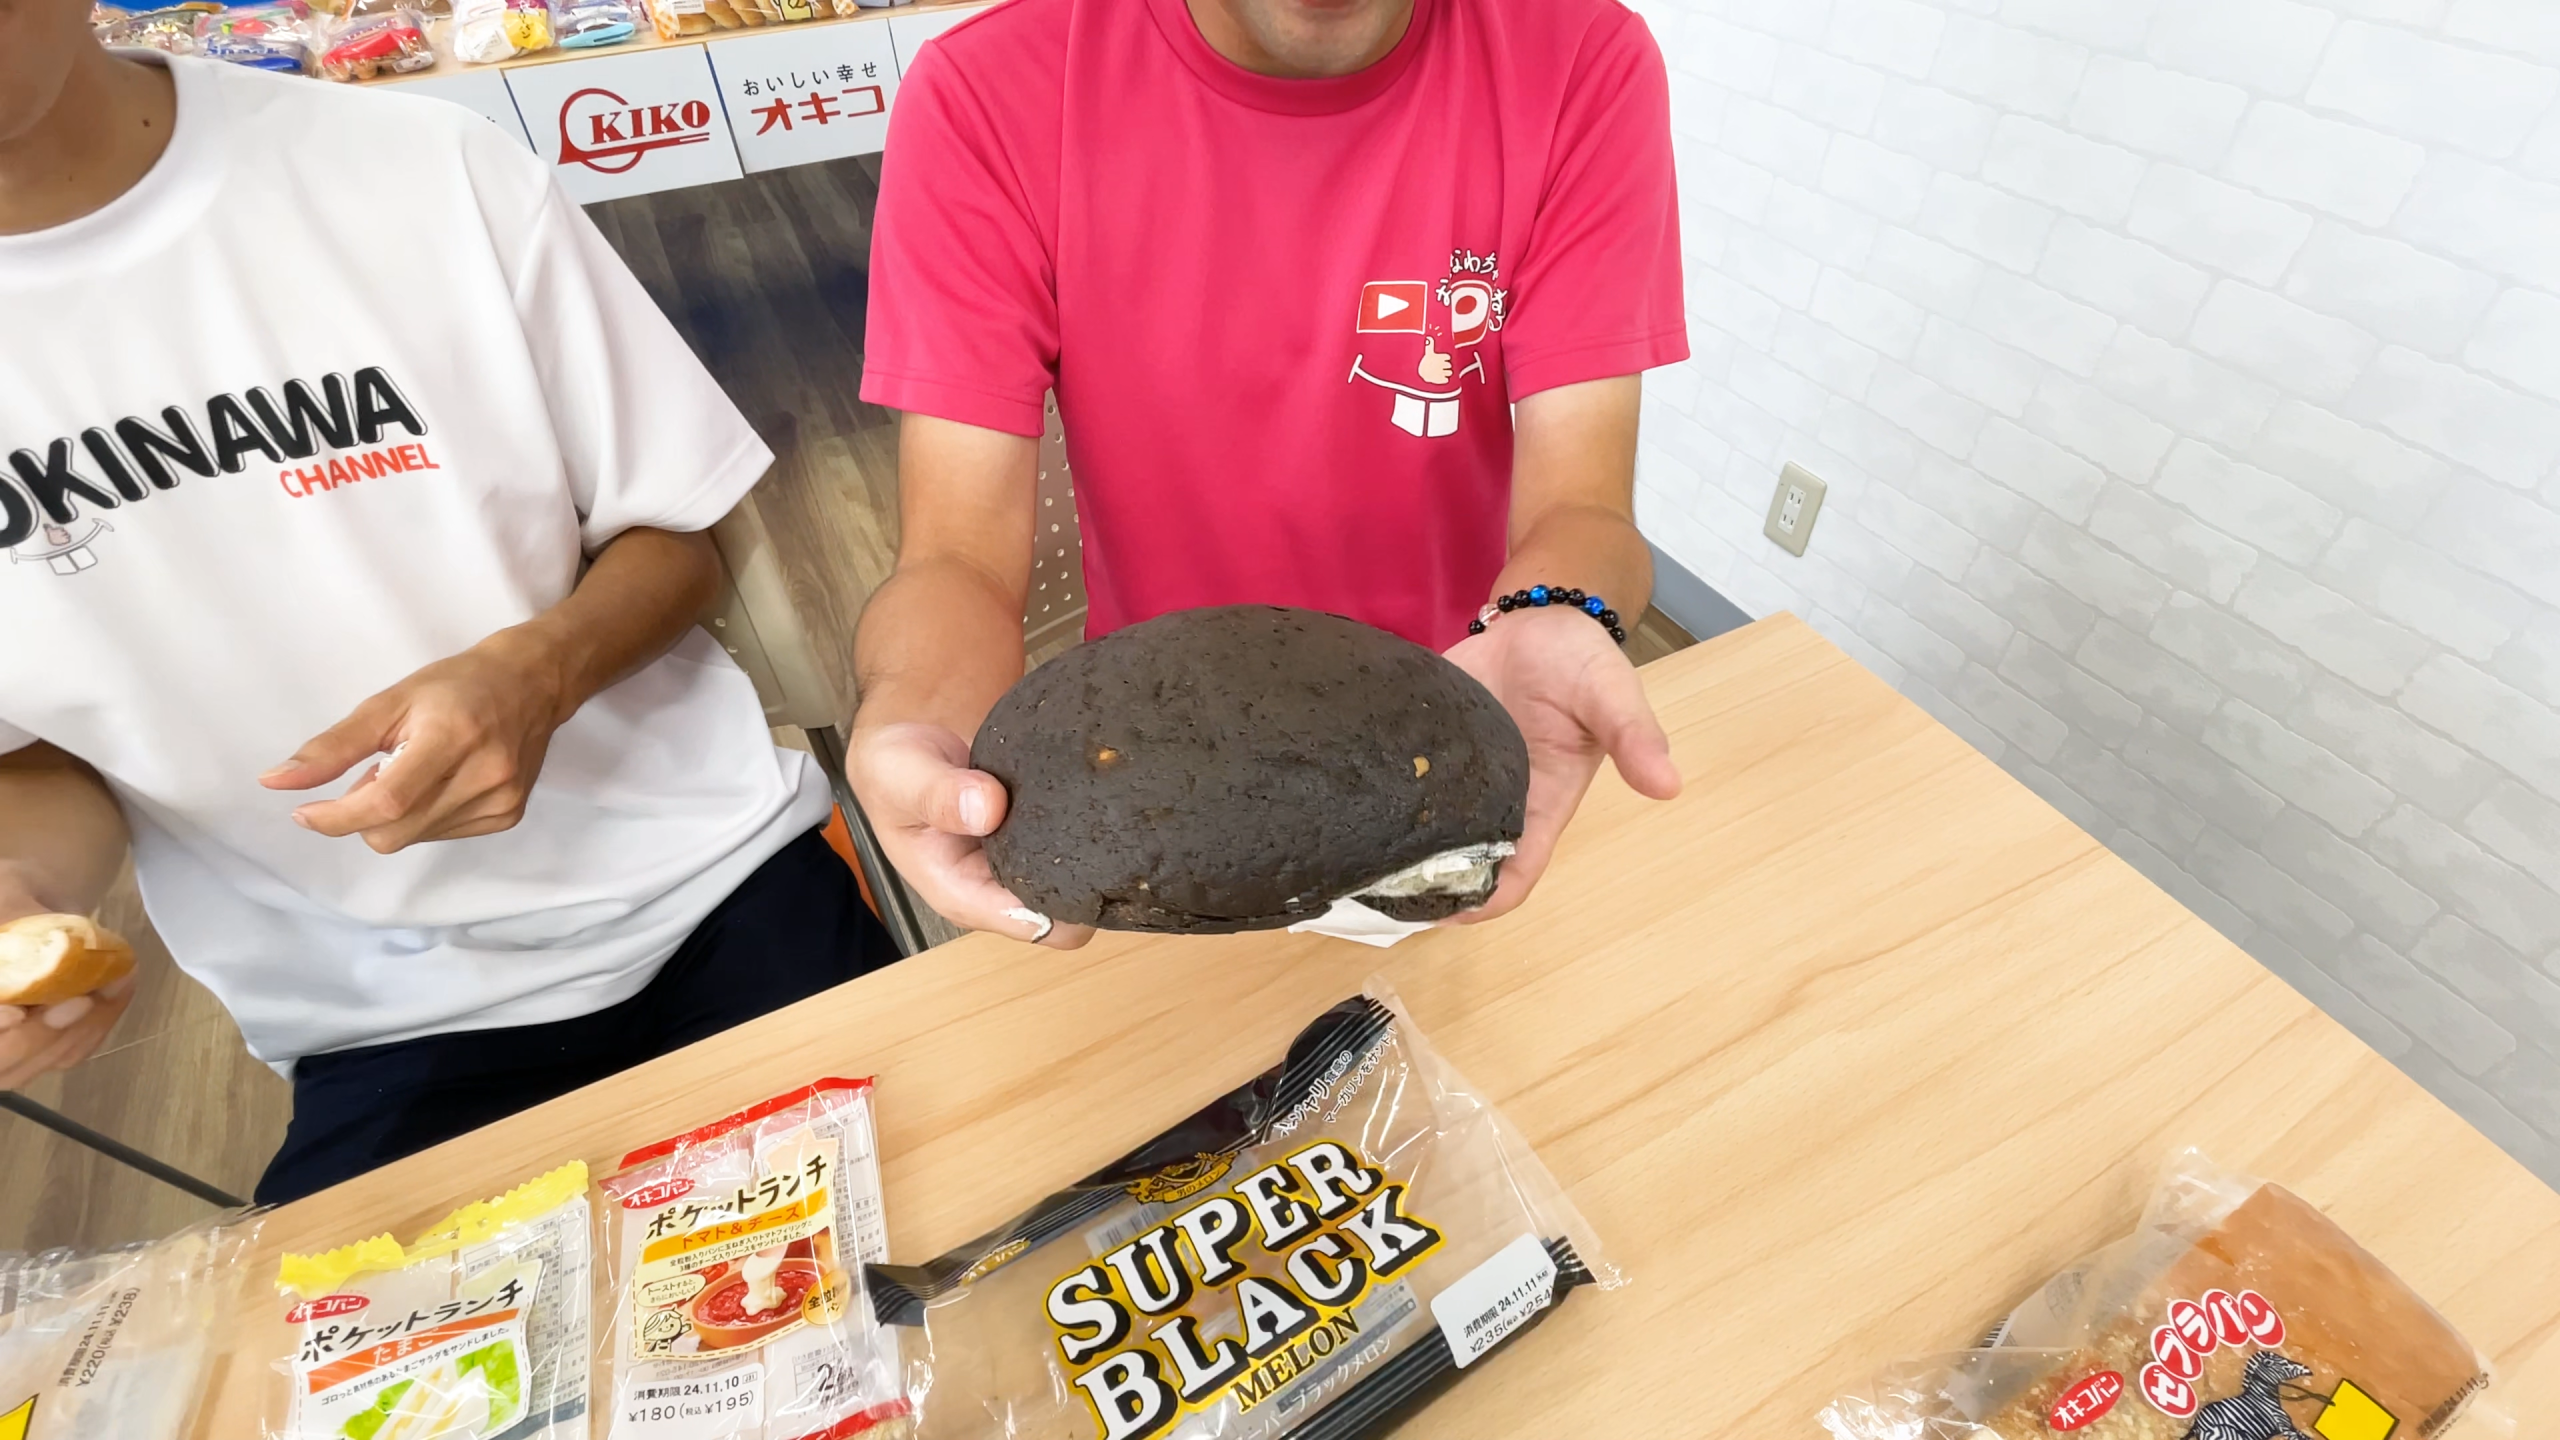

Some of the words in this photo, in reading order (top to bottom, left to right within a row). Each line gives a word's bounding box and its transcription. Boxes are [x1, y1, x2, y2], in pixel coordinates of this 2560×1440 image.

[743, 61, 878, 96] おいしい幸せ
[750, 84, 886, 136] オキコ
[279, 443, 440, 498] CHANNEL
[628, 1182, 695, 1207] オキコパン
[646, 1154, 828, 1240] ポケットランチ
[1045, 1141, 1384, 1366] SUPER
[300, 1278, 525, 1363] ポケットランチ
[1074, 1185, 1442, 1440] BLACK
[1498, 1277, 1538, 1313] 24.11.11
[1229, 1307, 1361, 1413] MELON
[2149, 1295, 2277, 1410] ゼブラパン
[683, 1375, 740, 1397] 24.11.10
[2054, 1375, 2120, 1429] オキコパン
